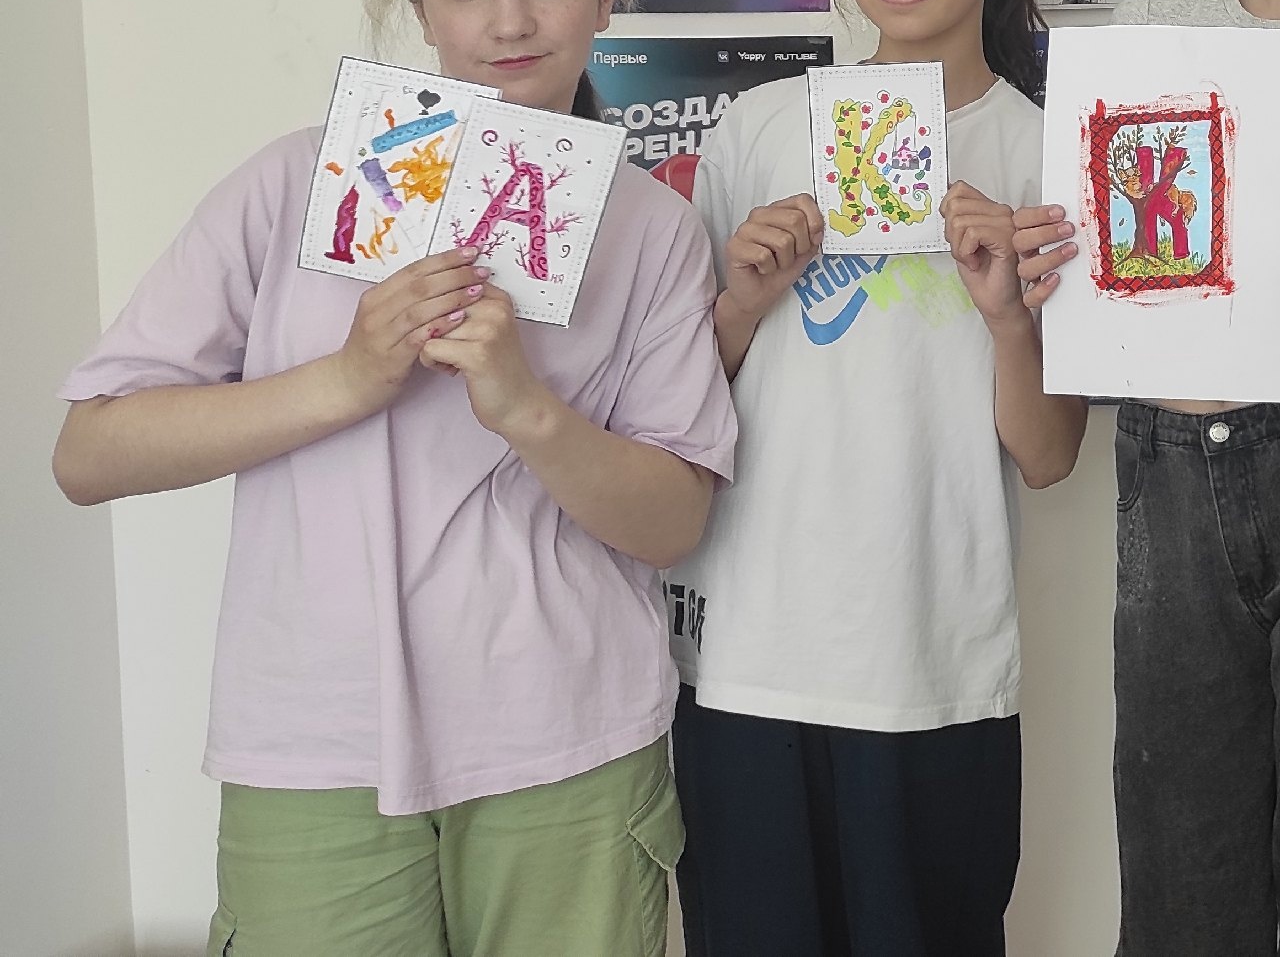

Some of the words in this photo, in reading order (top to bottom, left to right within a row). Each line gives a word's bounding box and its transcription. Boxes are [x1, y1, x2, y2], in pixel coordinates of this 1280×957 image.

[593, 51, 648, 68] Первые
[737, 51, 766, 62] Yappy
[623, 130, 701, 162] РЕН
